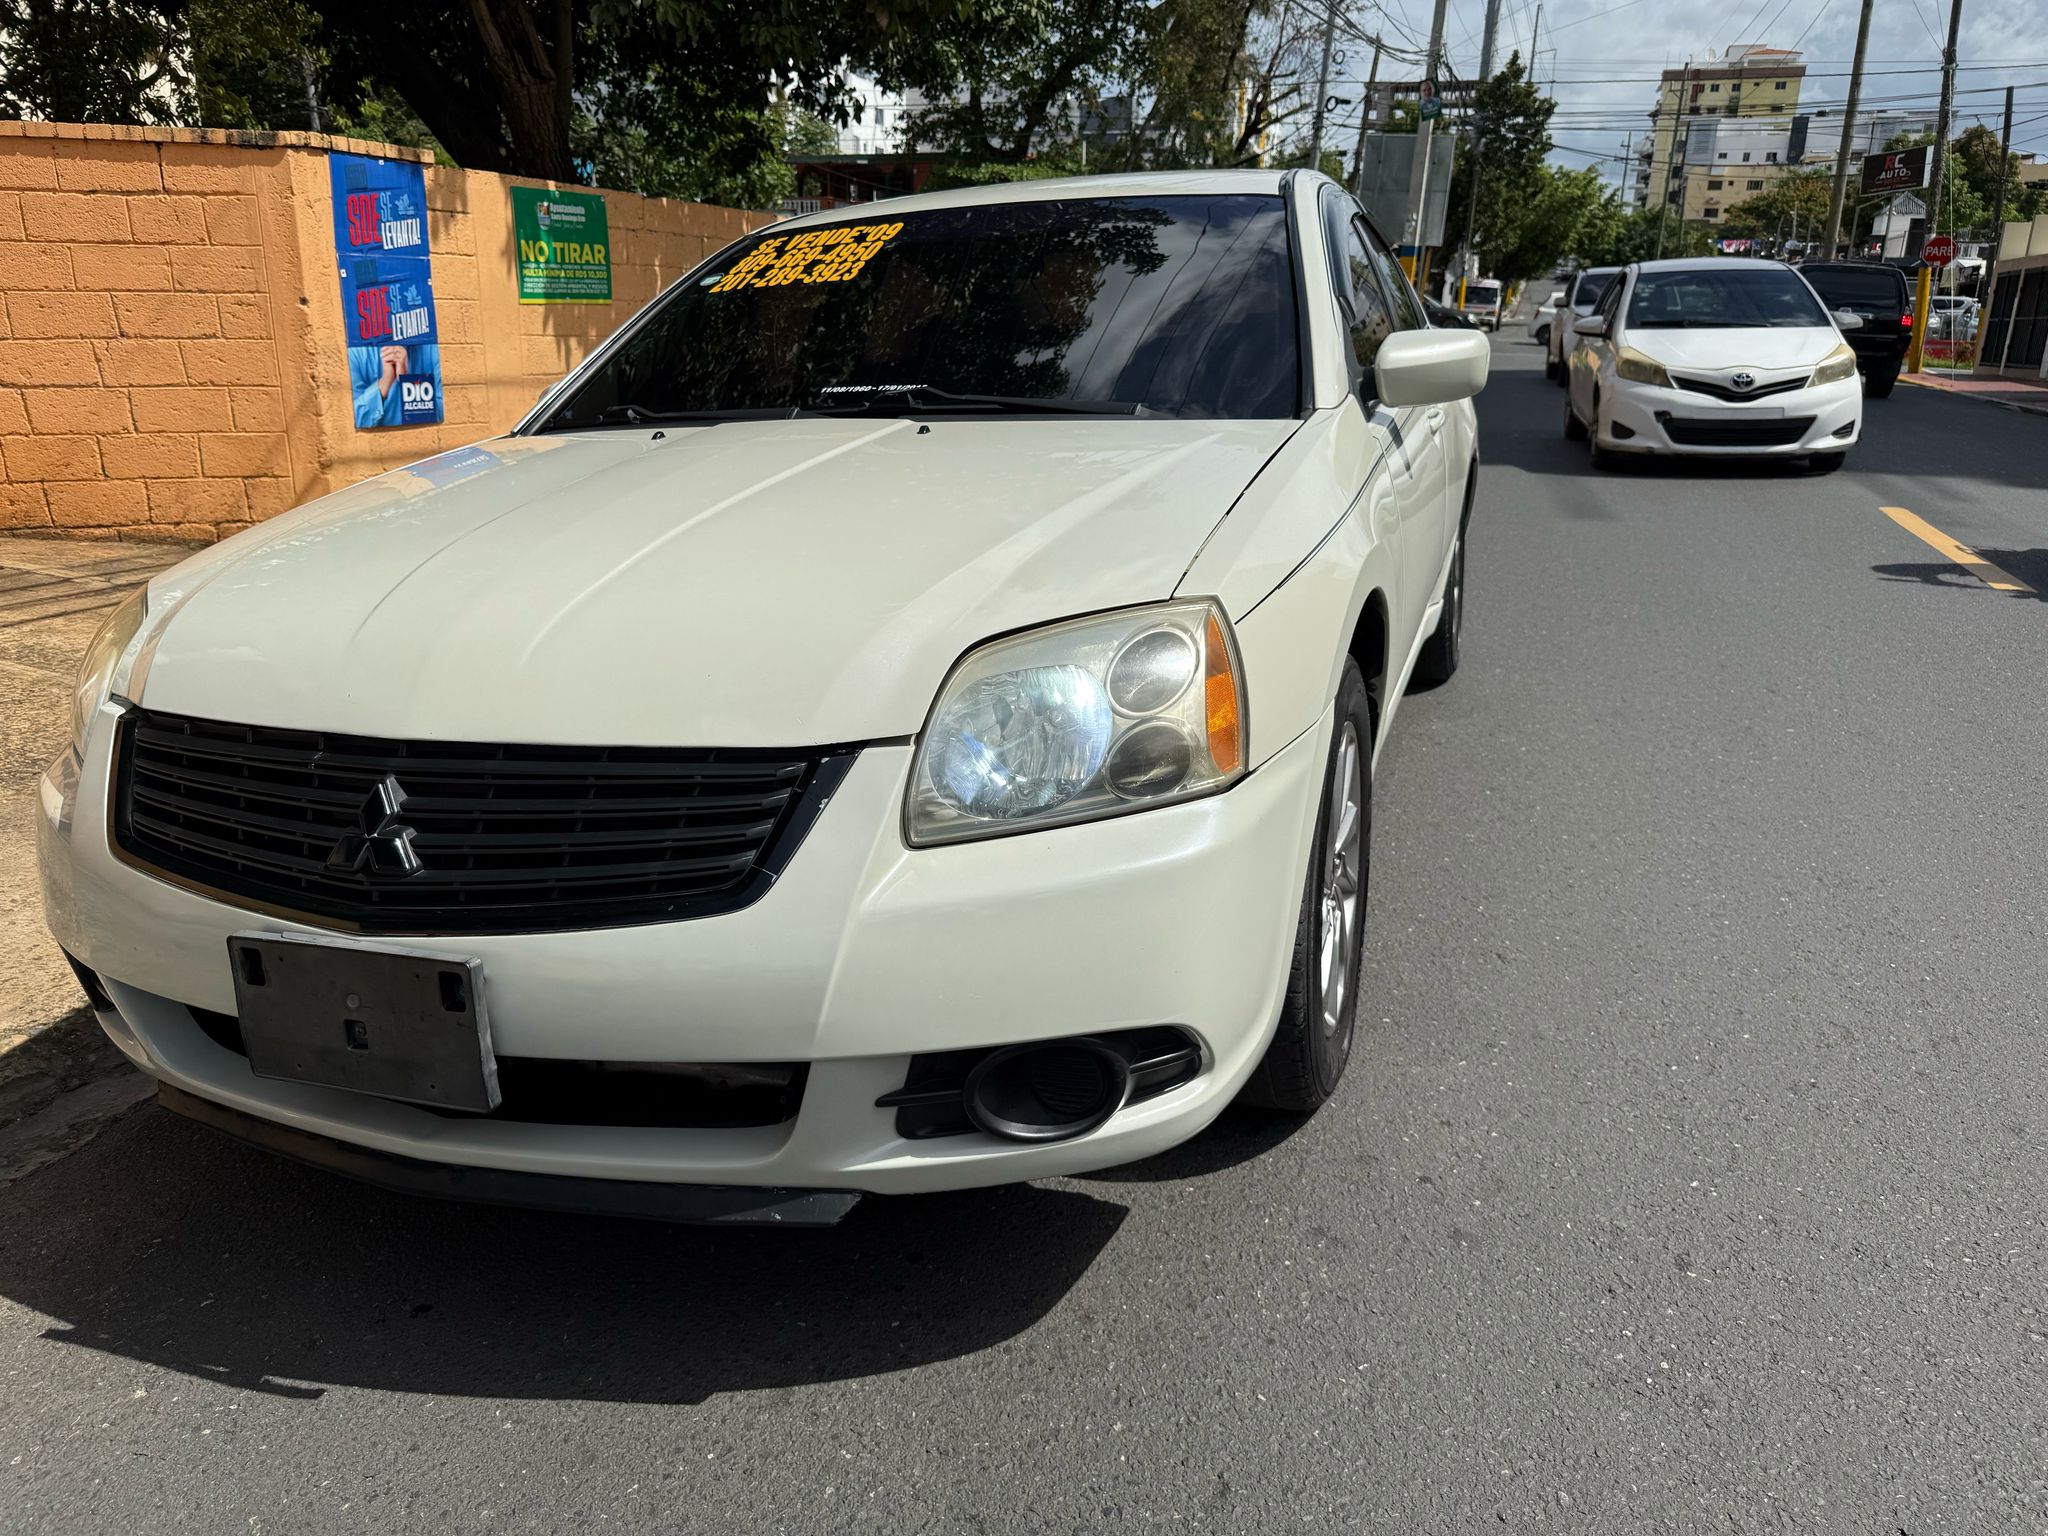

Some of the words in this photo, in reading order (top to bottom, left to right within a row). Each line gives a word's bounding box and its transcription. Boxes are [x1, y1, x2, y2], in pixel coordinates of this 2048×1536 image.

[1880, 168, 1907, 180] AUTO
[1885, 153, 1905, 170] RC
[347, 191, 383, 247] SDE
[380, 191, 394, 222] SE
[381, 217, 421, 250] LEVANTA!
[520, 239, 549, 263] NO
[552, 241, 607, 265] TIRAR
[729, 241, 884, 275] 809-669-4950
[751, 236, 789, 256] SE
[1925, 245, 1955, 257] PARE
[709, 261, 865, 293] 201-289-3923
[357, 286, 393, 340] SDE
[389, 283, 403, 313] SE
[391, 306, 430, 341] LEVANTA!
[403, 401, 435, 410] ALCALDE
